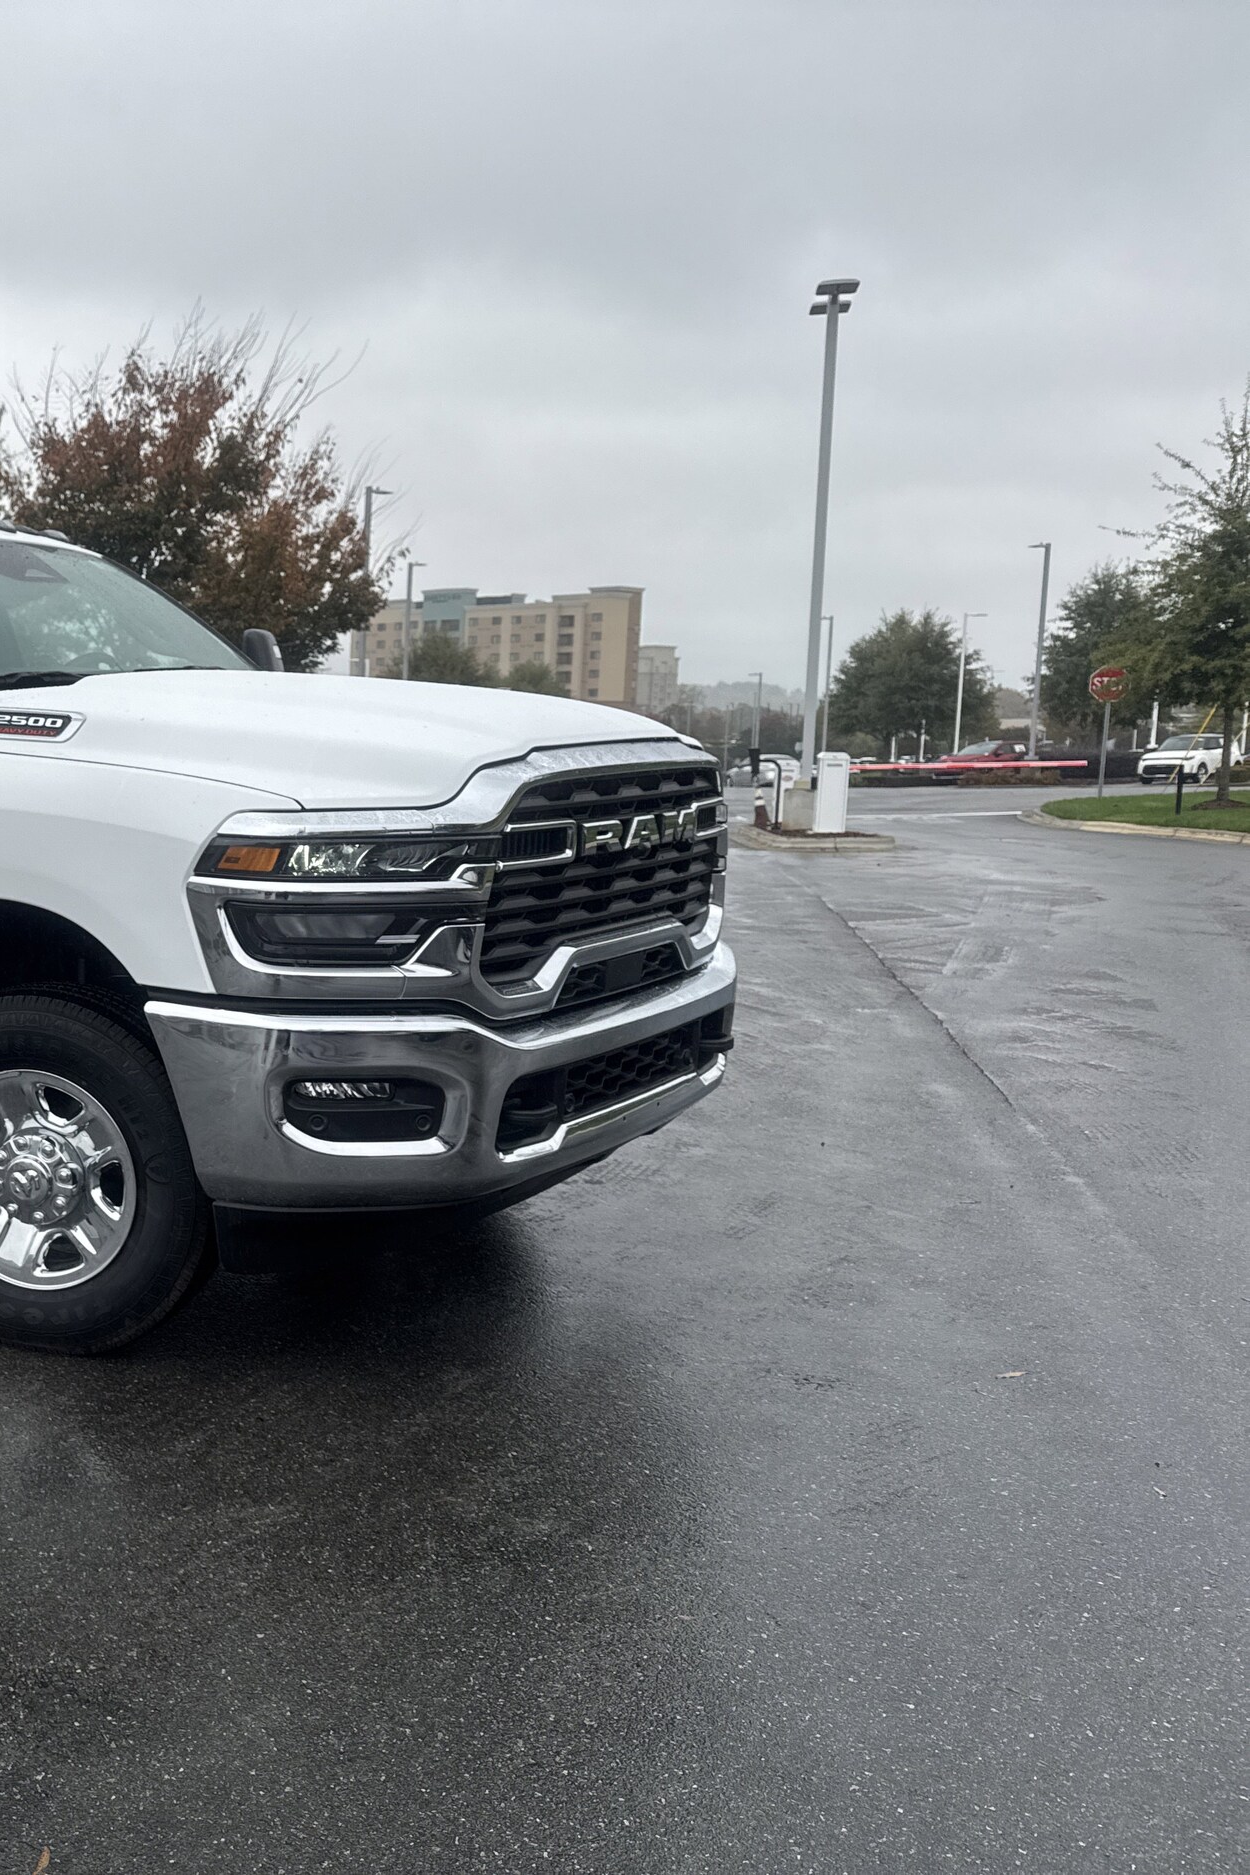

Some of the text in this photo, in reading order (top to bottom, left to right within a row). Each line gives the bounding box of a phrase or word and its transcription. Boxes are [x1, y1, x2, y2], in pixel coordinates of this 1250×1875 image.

[1092, 677, 1125, 690] ST
[25, 728, 57, 736] DUTY
[581, 809, 696, 855] RAM
